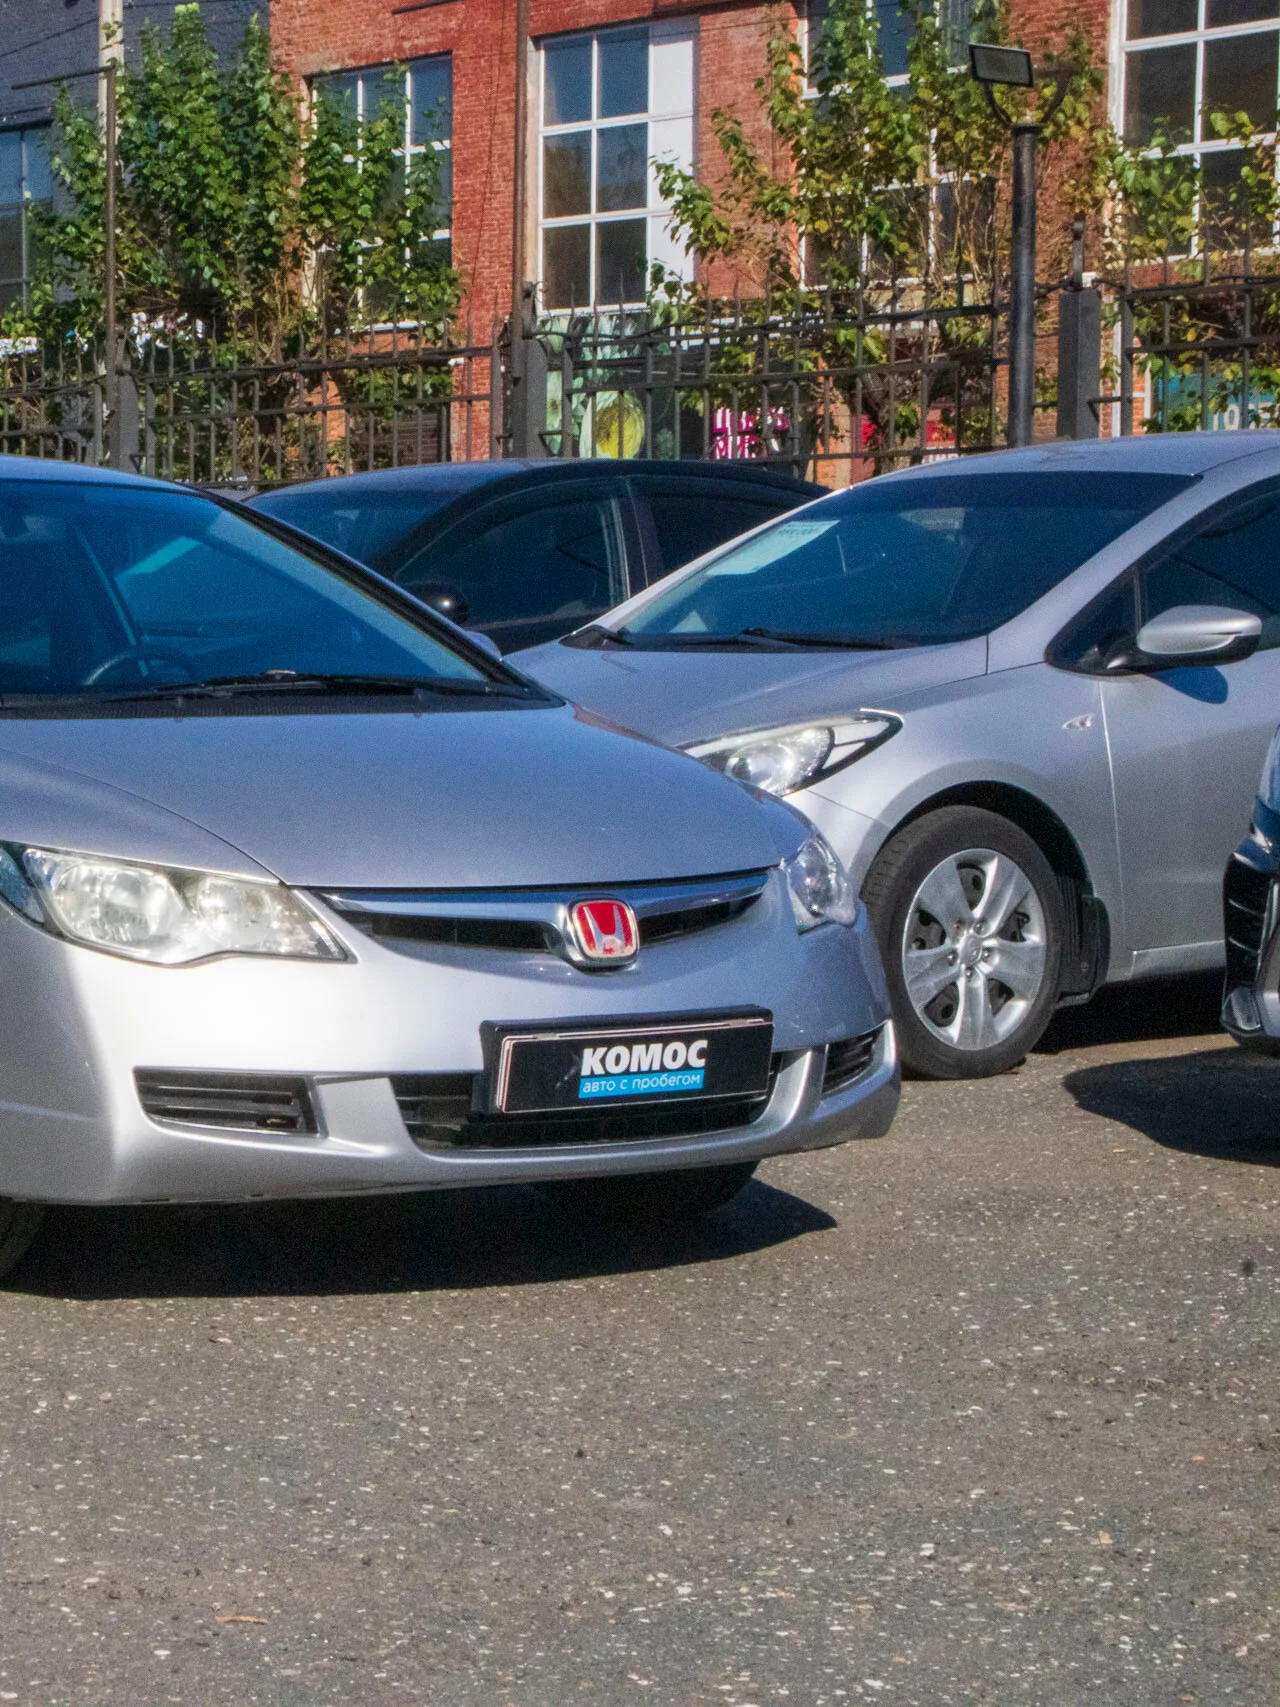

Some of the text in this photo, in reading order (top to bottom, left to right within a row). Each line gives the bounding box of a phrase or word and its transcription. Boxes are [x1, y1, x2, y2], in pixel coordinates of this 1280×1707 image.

[581, 1039, 708, 1076] КОМОС
[583, 1073, 701, 1093] авто с пробегом
